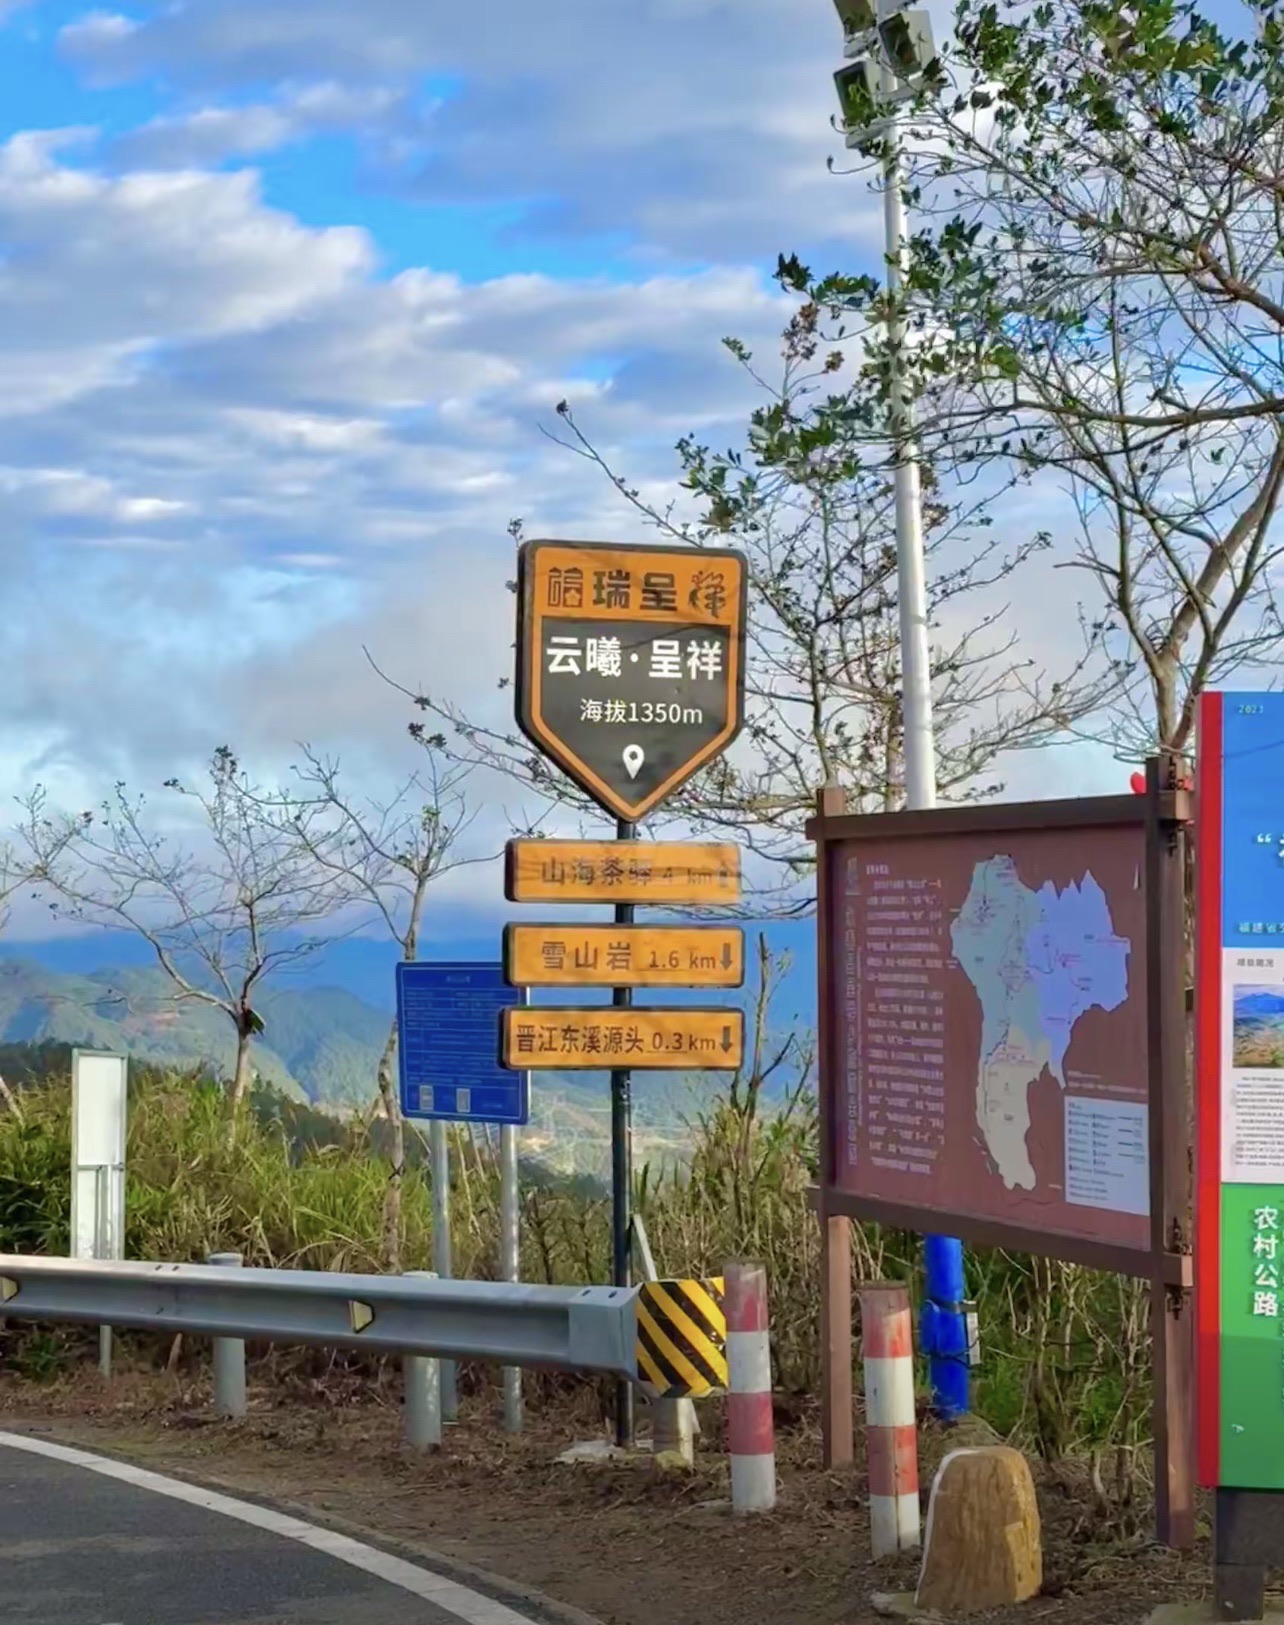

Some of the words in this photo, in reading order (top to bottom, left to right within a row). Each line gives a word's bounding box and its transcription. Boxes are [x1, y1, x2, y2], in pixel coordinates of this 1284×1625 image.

[546, 636, 722, 680] 云曦·呈祥
[580, 698, 703, 724] 海拔1350m
[541, 940, 632, 971] 雪山岩
[649, 950, 680, 969] 1.6
[689, 950, 716, 969] km
[517, 1024, 644, 1054] 晋江东溪源头
[652, 1031, 683, 1050] 0.3
[689, 1033, 716, 1050] km
[1253, 1205, 1279, 1317] 农村公路
